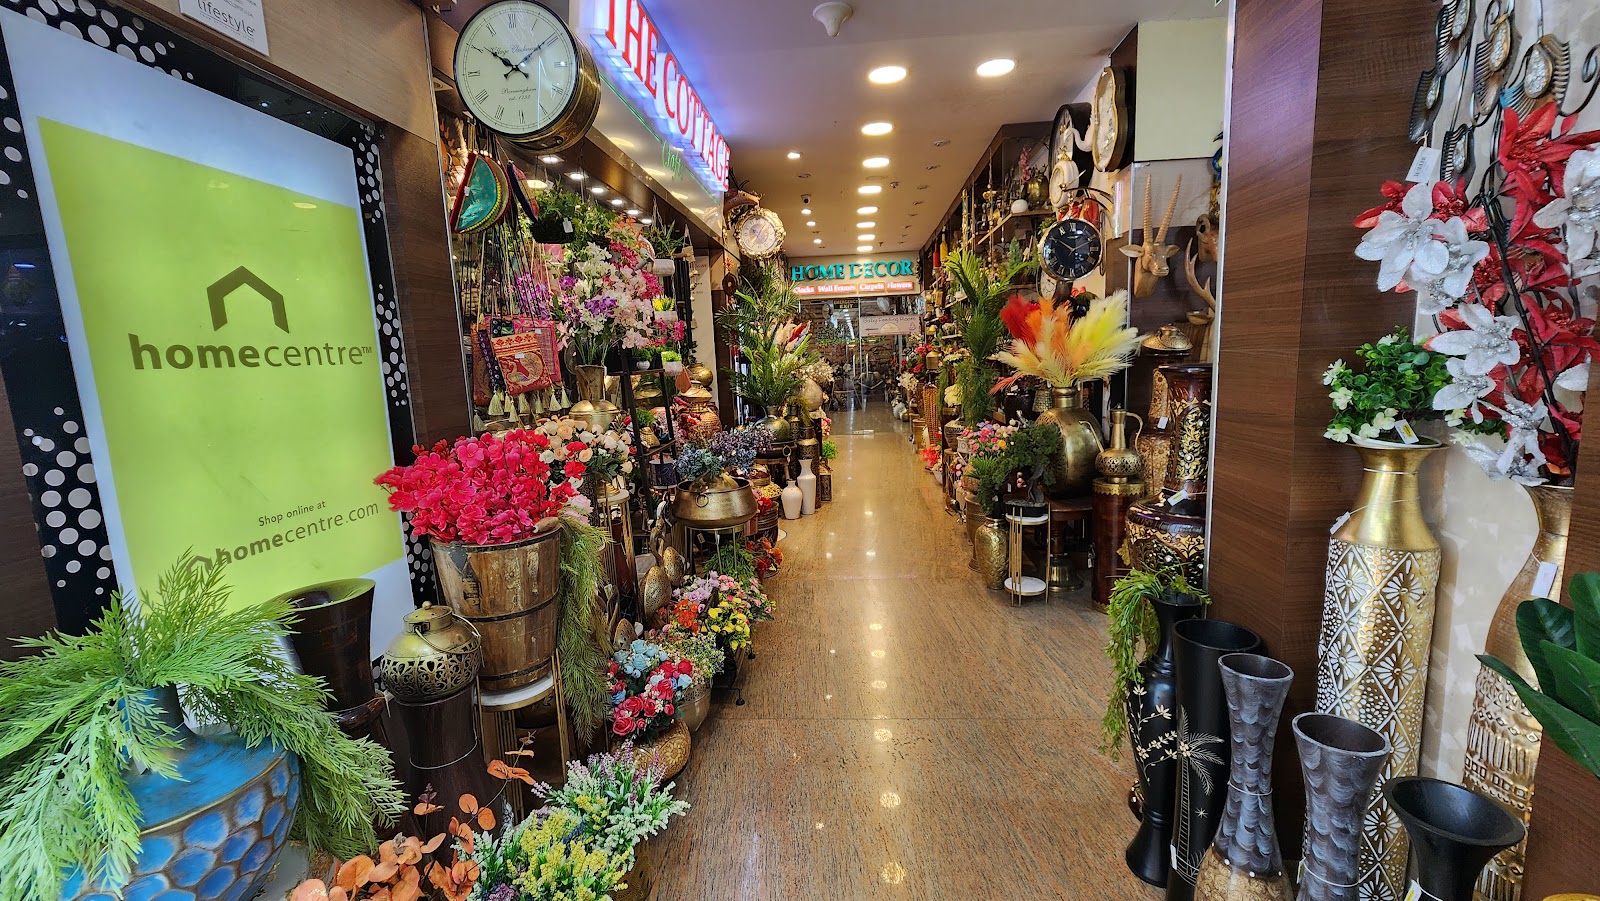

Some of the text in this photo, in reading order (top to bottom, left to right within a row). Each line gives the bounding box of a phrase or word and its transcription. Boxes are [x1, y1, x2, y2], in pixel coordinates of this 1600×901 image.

[664, 52, 730, 190] COTTAGE
[791, 260, 913, 281] HOME DECOR
[817, 284, 833, 293] Wall
[859, 282, 885, 292] Carpets
[258, 500, 326, 527] Shop online at
[215, 503, 379, 568] homecentre.com
